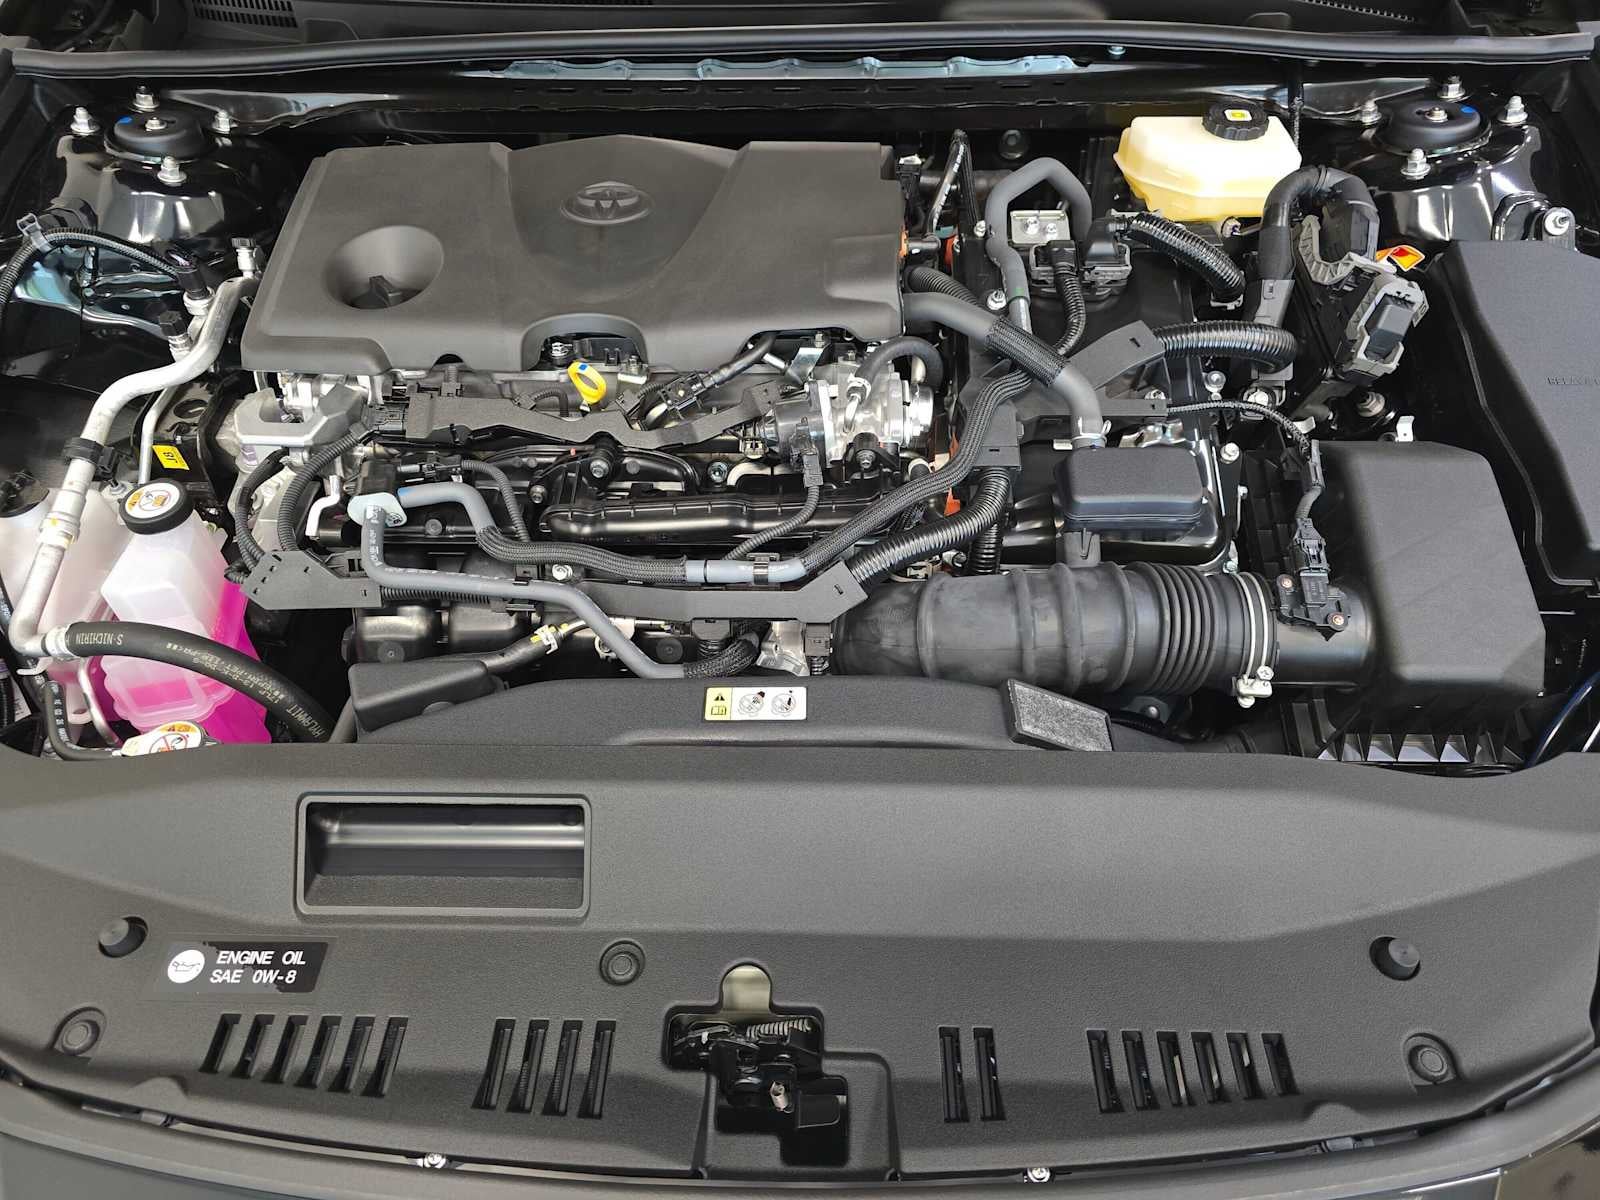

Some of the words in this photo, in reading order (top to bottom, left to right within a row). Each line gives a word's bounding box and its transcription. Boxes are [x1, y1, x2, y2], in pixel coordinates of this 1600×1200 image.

[216, 950, 275, 965] ENGINE
[281, 950, 306, 965] OIL
[209, 969, 244, 984] SAE
[252, 969, 297, 984] 0W-8
